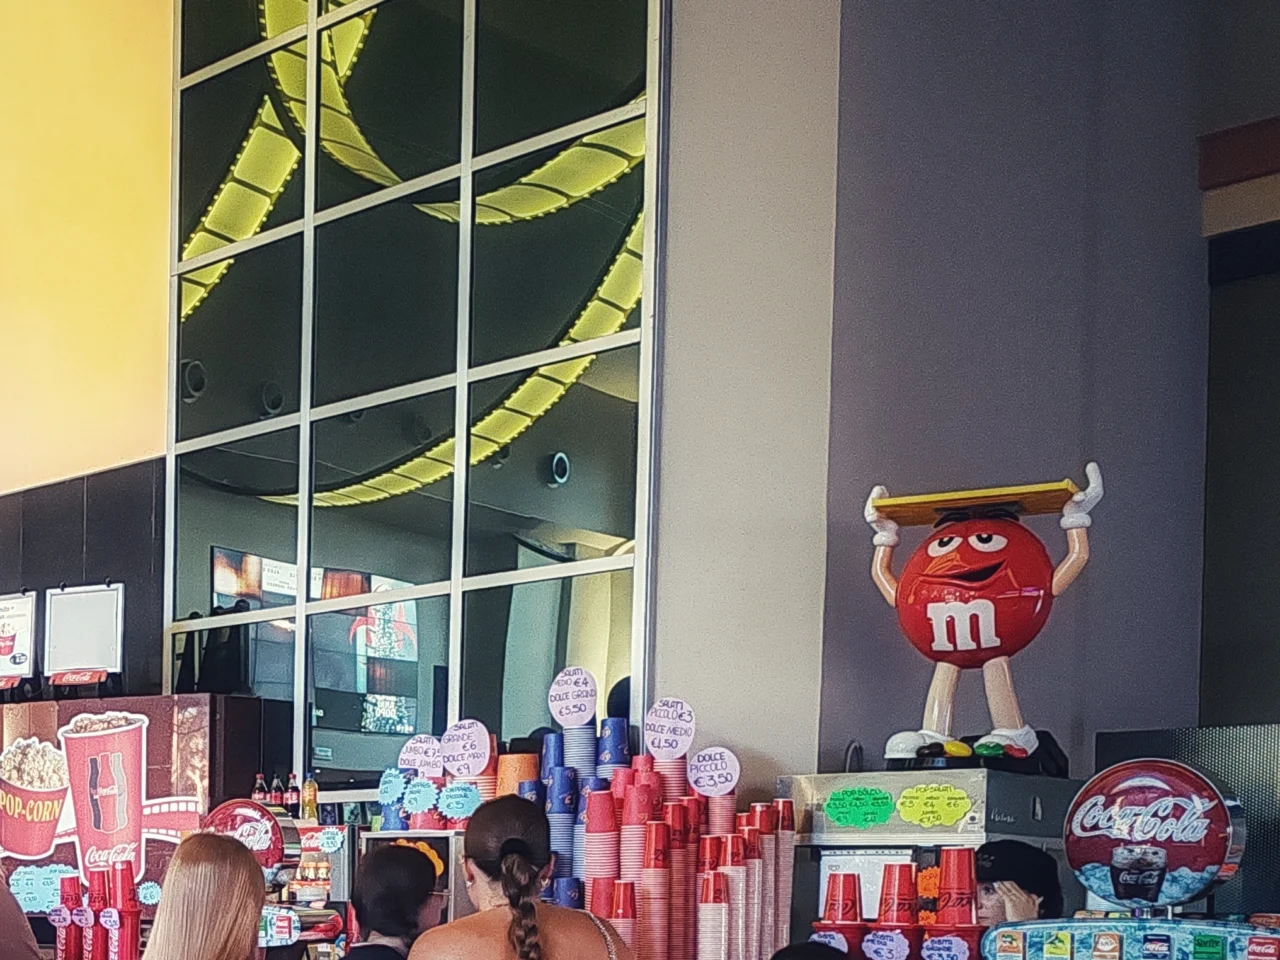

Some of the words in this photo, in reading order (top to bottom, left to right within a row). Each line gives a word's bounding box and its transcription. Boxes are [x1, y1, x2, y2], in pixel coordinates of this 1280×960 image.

[574, 677, 589, 687] €4
[550, 692, 570, 702] DOLCE
[559, 704, 586, 716] €5,50
[678, 710, 693, 723] €3
[454, 722, 478, 731] SALATI
[646, 723, 666, 734] DOLCE
[666, 726, 692, 737] MEDIO
[411, 736, 434, 744] SALATI
[443, 732, 474, 744] GRANDE
[402, 746, 423, 754] JUMBO
[462, 741, 476, 751] €6
[400, 758, 416, 766] DOLCE
[418, 760, 440, 768] JUMBO
[442, 754, 465, 763] DOLCE
[697, 752, 725, 763] DOLCE
[457, 763, 470, 775] €9
[690, 761, 727, 773] PICCOLO
[694, 773, 733, 788] €3,50
[1072, 795, 1218, 842] Coca-Cola
[85, 842, 139, 867] Coca-Cola
[1120, 871, 1160, 884] Coca-Cola
